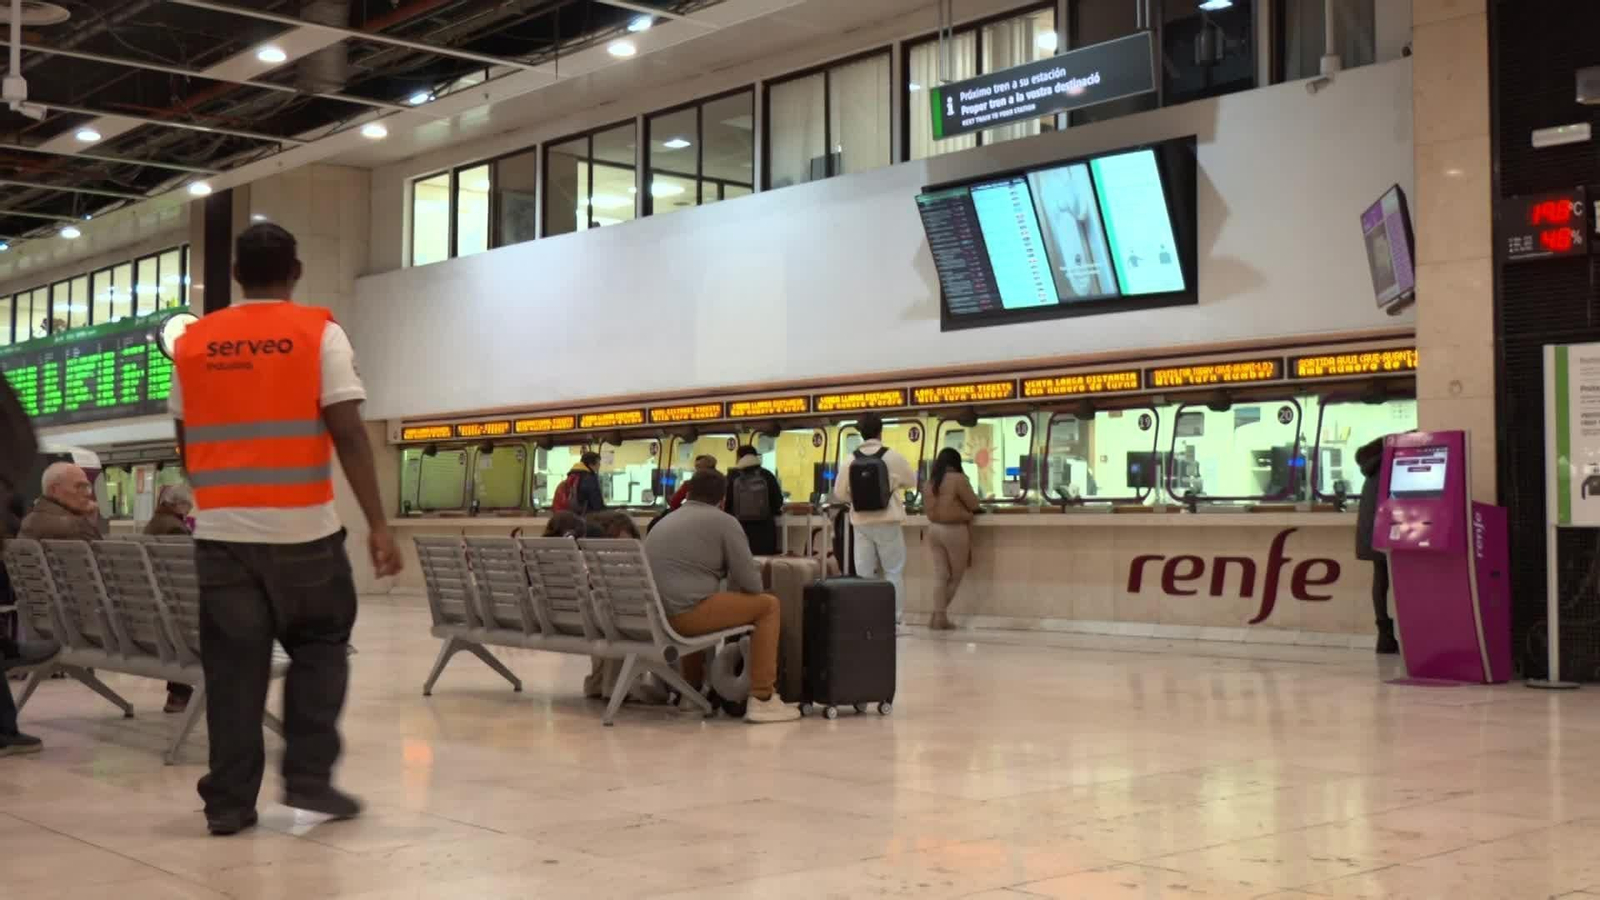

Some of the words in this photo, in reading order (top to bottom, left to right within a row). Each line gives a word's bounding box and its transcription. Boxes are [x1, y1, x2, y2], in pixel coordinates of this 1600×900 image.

[960, 85, 992, 102] Próximo
[993, 81, 1010, 94] tren
[1012, 79, 1018, 88] a
[1019, 78, 1029, 88] su
[1031, 66, 1066, 84] estación
[960, 99, 987, 116] Proper
[989, 96, 1006, 110] tren
[1008, 95, 1014, 104] a
[1016, 92, 1024, 103] la
[1026, 85, 1053, 100] vostra
[1054, 72, 1100, 94] destinació
[962, 117, 975, 126] NEXT
[976, 114, 991, 124] TRAIN
[1000, 108, 1014, 118] YOUR
[1014, 103, 1036, 114] STATION
[207, 338, 294, 357] serveo
[1024, 379, 1053, 388] VENTA
[1055, 376, 1084, 386] LARGA
[1086, 372, 1137, 384] DISTANCIA
[1189, 373, 1217, 384] turn
[1224, 369, 1272, 381] number
[1139, 416, 1151, 429] 19
[1279, 410, 1292, 422] 20
[1017, 422, 1027, 435] 18
[1127, 527, 1341, 624] renfe
